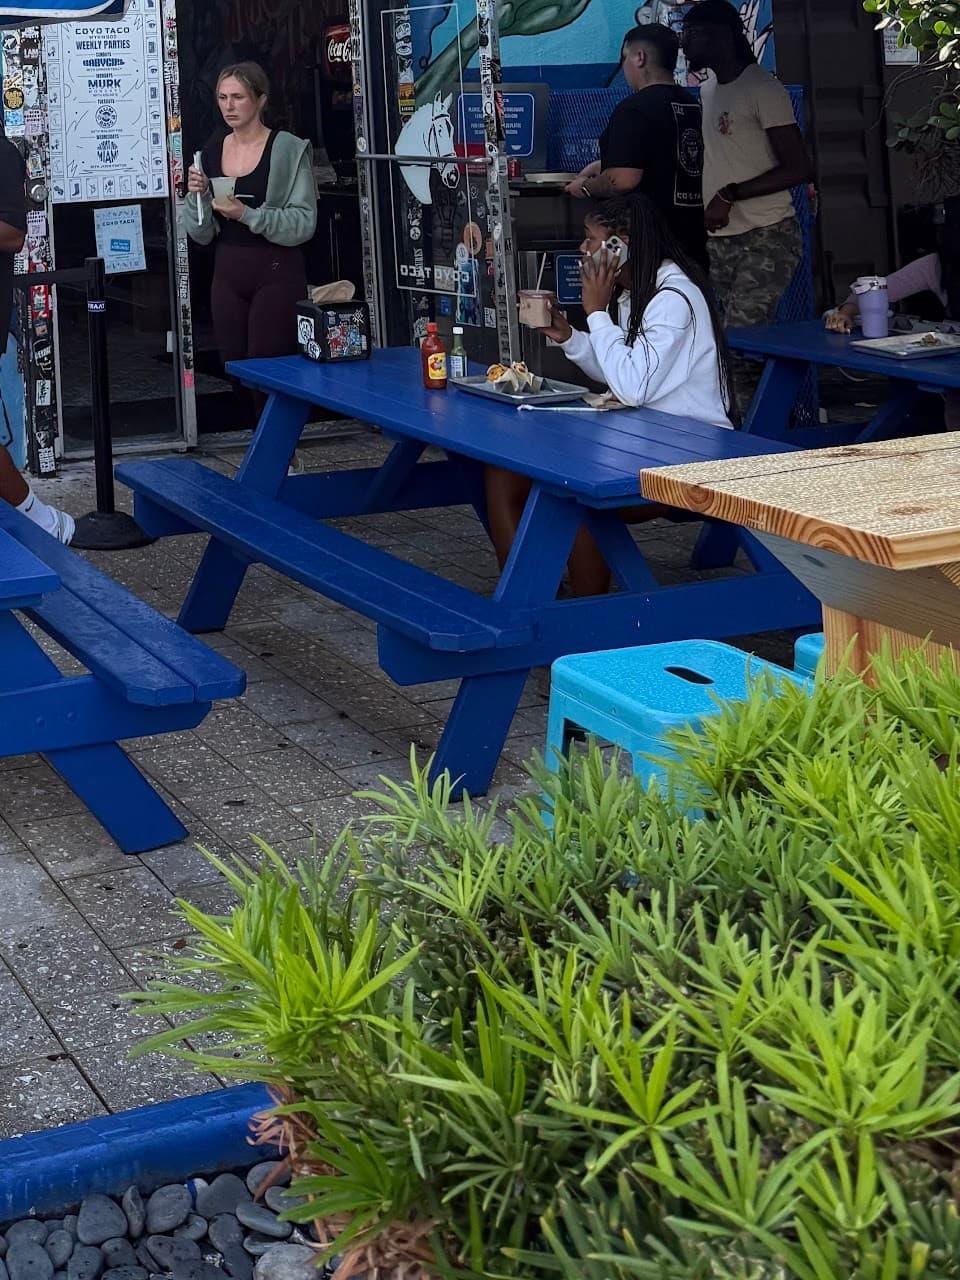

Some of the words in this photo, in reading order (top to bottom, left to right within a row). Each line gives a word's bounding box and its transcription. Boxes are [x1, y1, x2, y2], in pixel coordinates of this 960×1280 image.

[76, 40, 102, 50] WEEKLY
[104, 39, 131, 49] PARTIES
[88, 79, 121, 88] MURK
